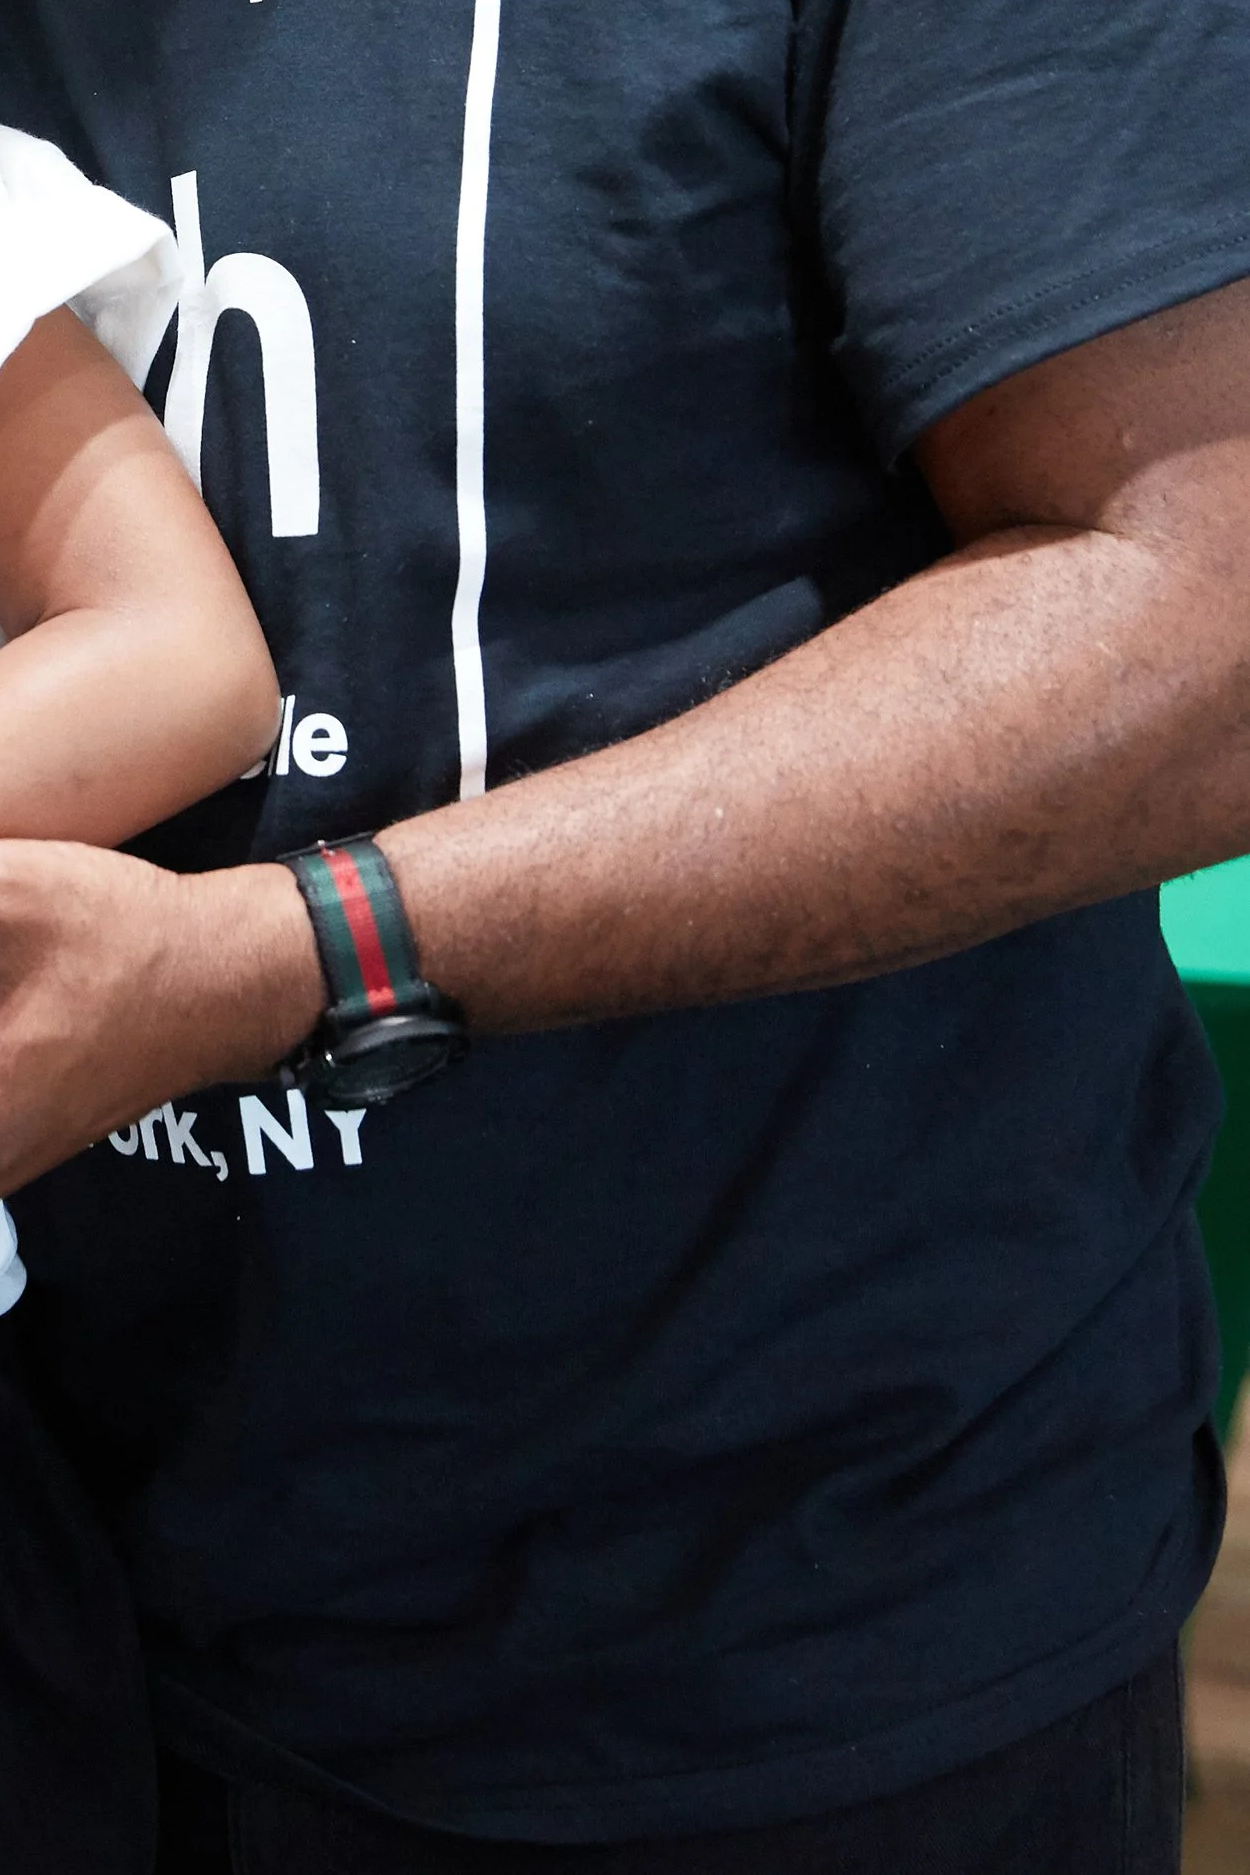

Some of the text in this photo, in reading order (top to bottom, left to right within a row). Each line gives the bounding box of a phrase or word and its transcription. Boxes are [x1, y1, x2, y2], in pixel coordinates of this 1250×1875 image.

[164, 170, 320, 538] h
[106, 1088, 367, 1182] ork, NY
